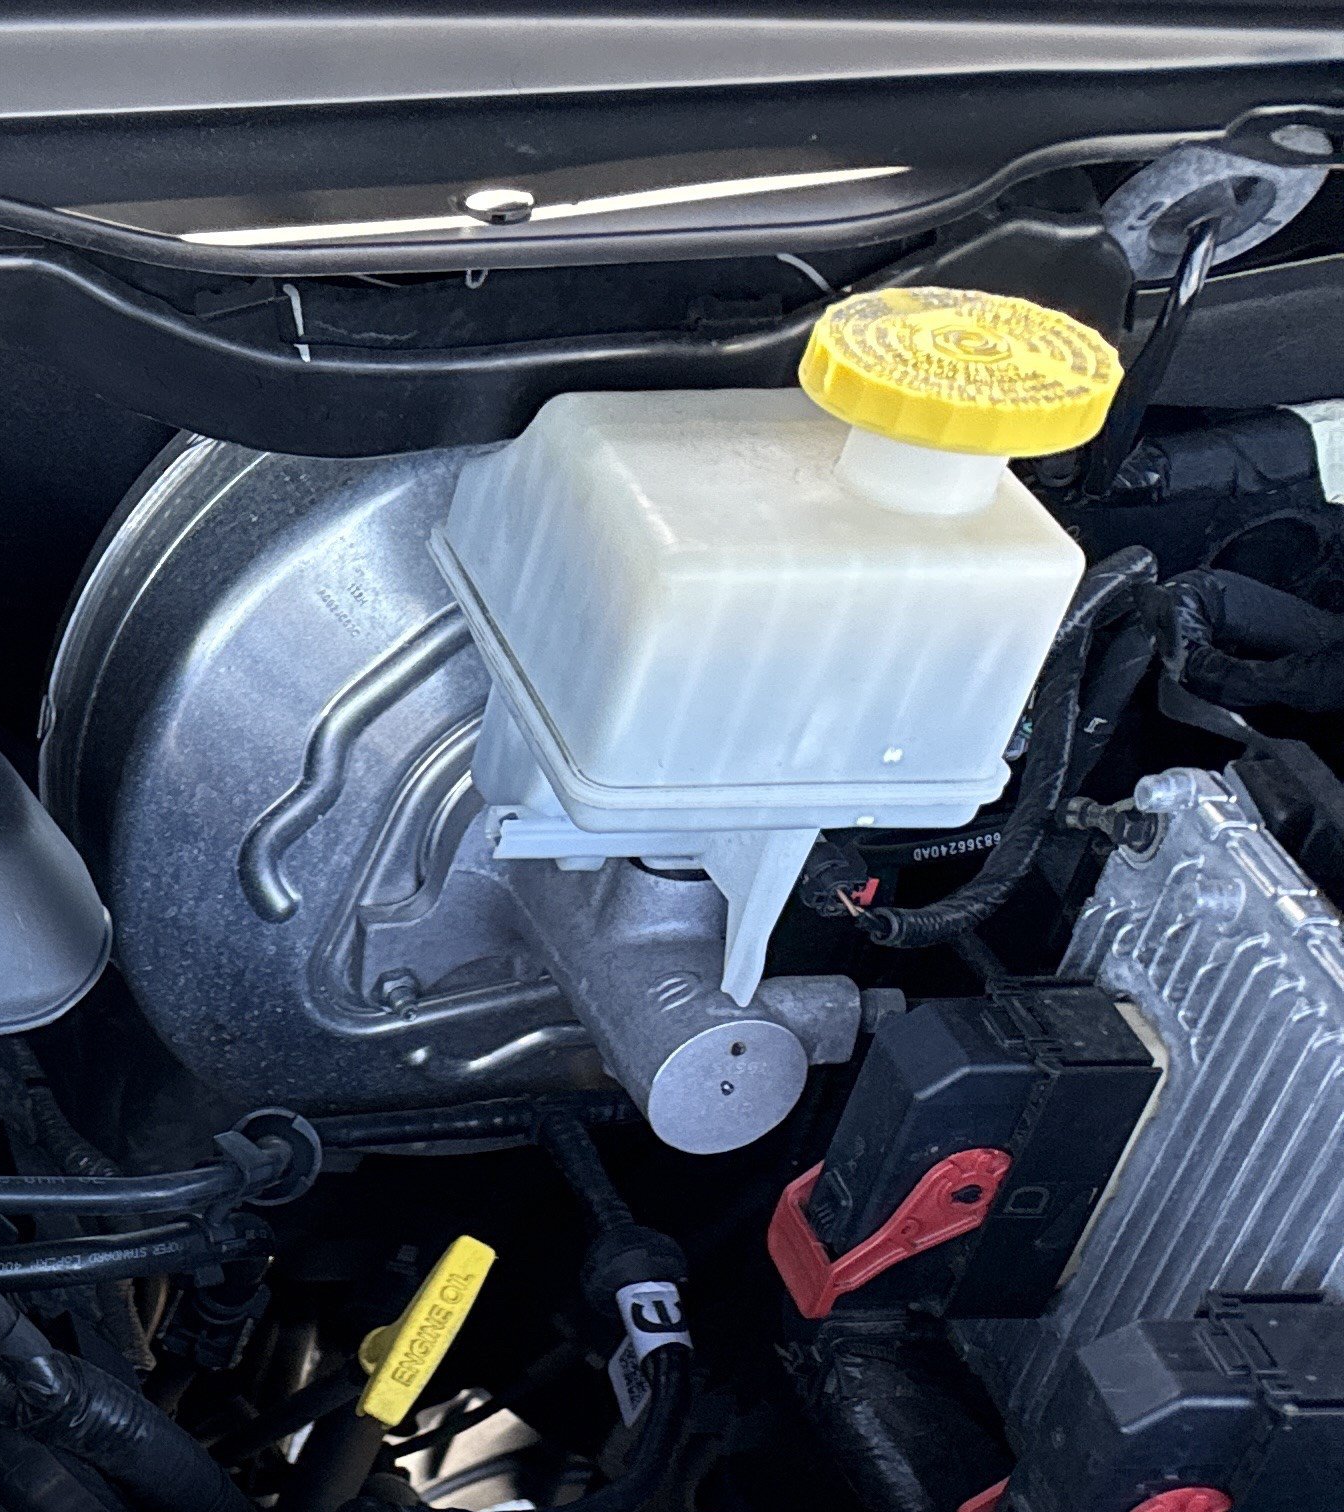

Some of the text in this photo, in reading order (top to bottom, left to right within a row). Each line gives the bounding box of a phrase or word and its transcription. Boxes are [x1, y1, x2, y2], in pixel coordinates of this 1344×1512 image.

[912, 831, 1002, 862] 68366240AD
[390, 1271, 475, 1388] ENGINE OIL
